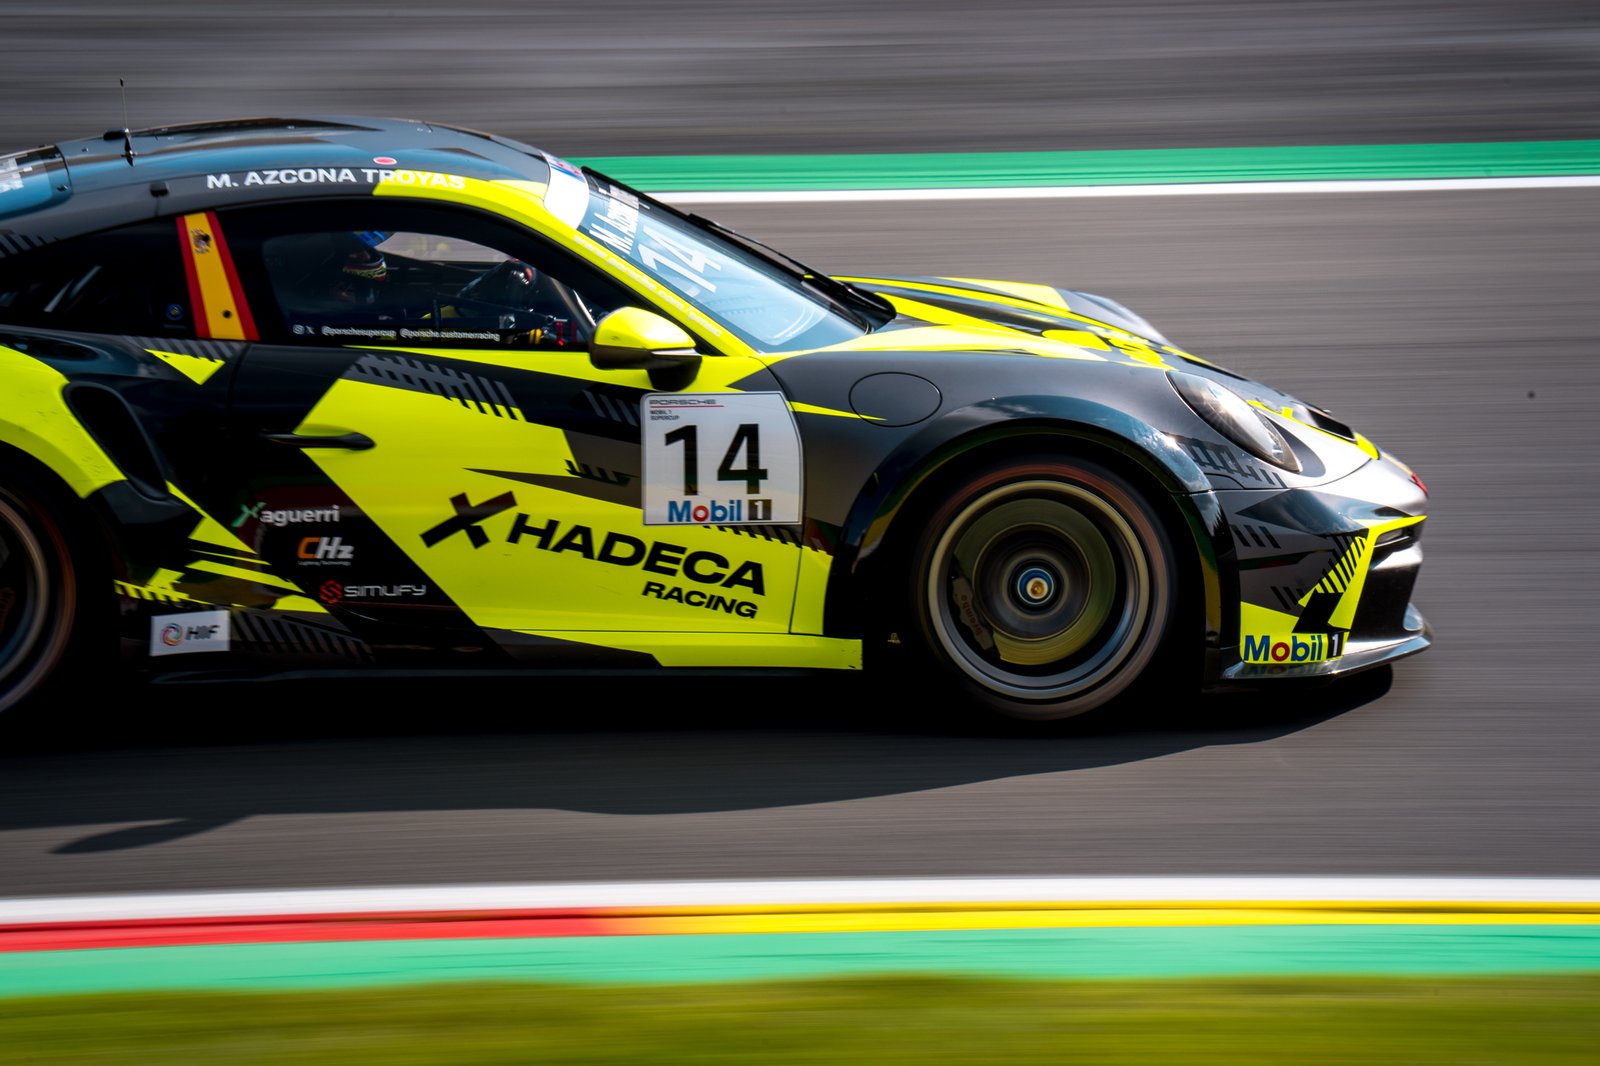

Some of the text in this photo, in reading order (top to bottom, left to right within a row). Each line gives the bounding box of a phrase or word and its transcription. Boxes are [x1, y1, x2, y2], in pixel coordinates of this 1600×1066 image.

[206, 168, 466, 190] M. AZCONA TROYAS
[637, 225, 722, 293] 14
[664, 423, 768, 496] 14
[668, 499, 742, 522] Mobil
[297, 536, 354, 559] CHz
[506, 512, 766, 597] HADECA
[641, 580, 759, 619] RACING
[1243, 634, 1323, 662] Mobil
